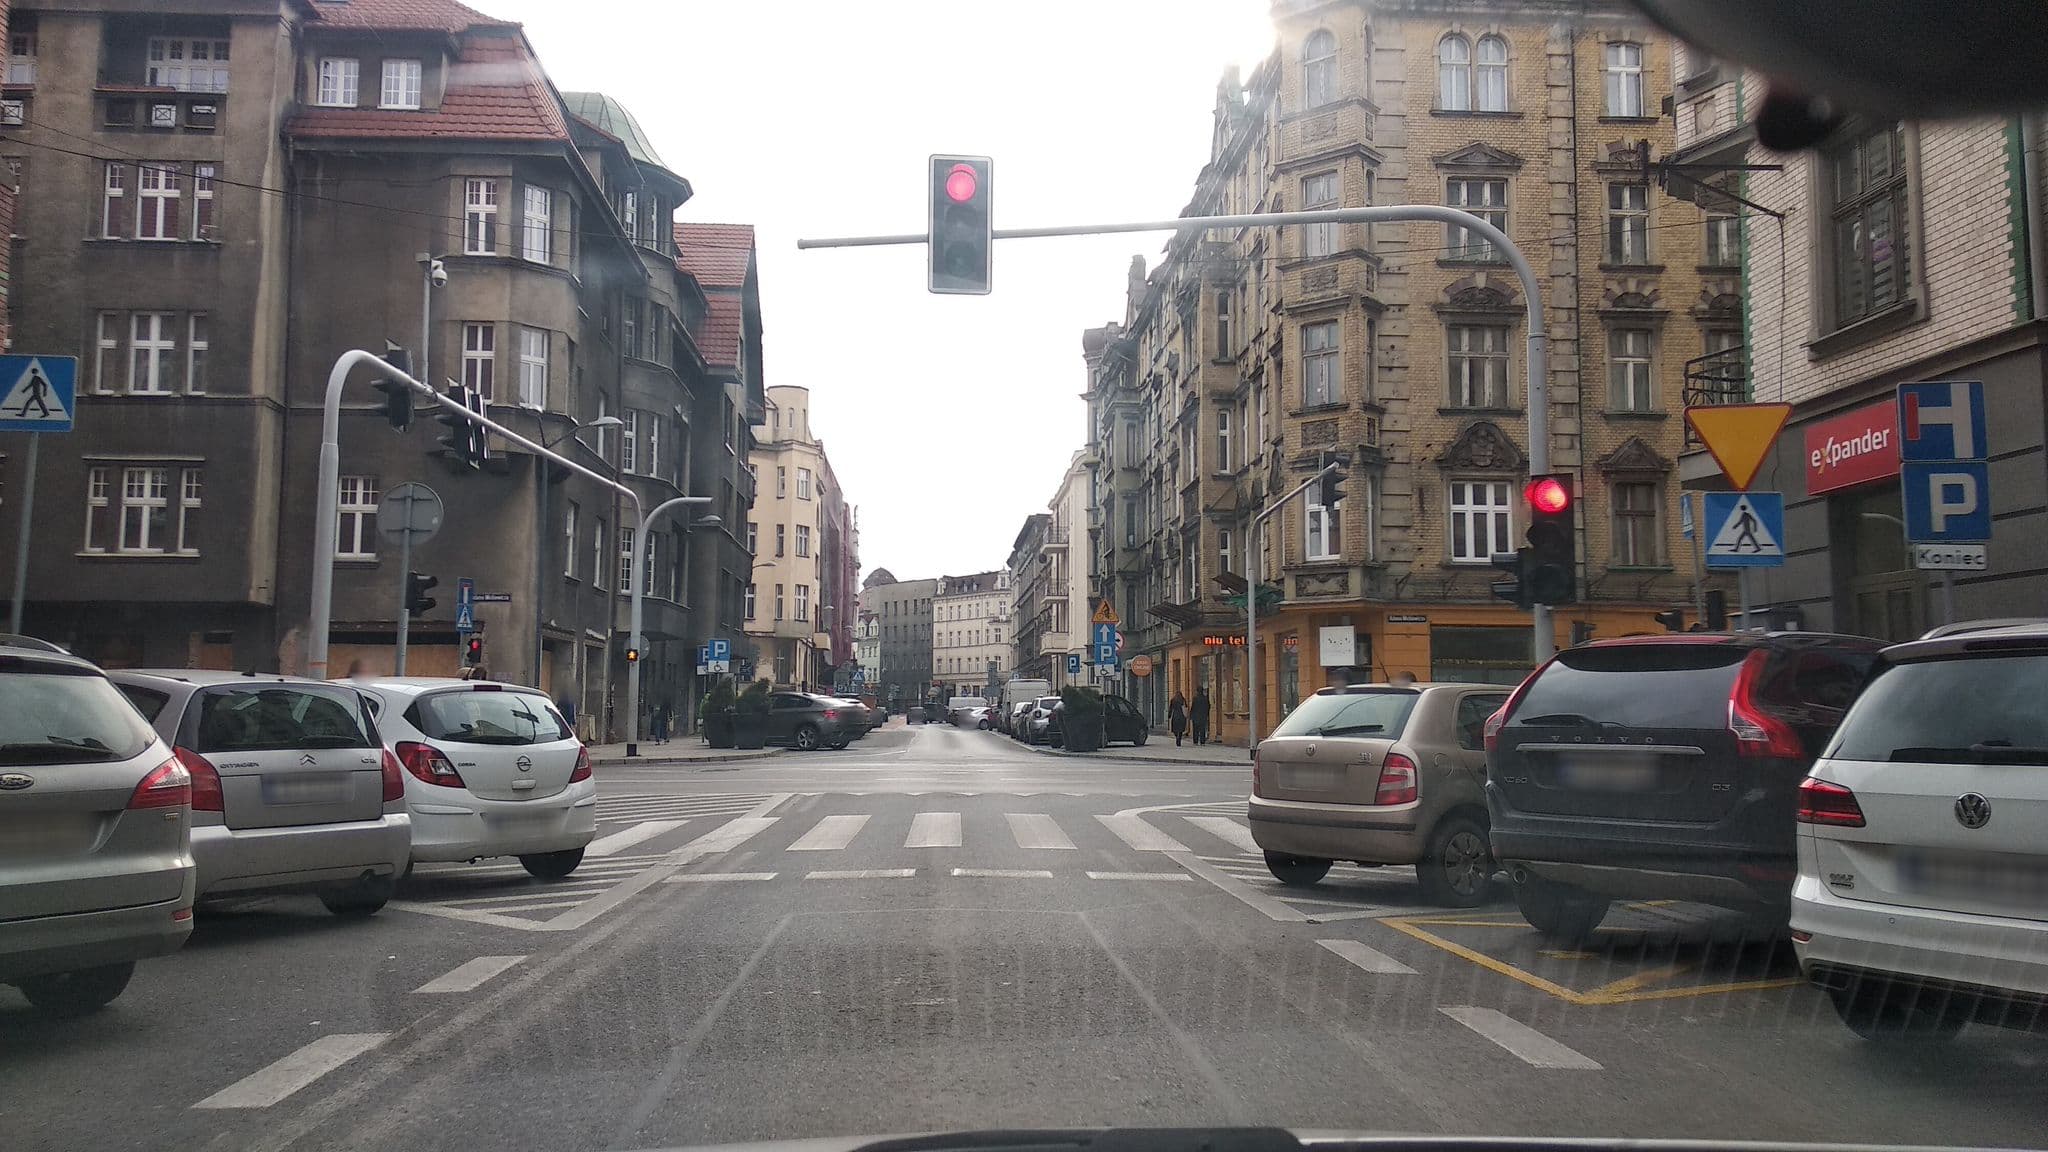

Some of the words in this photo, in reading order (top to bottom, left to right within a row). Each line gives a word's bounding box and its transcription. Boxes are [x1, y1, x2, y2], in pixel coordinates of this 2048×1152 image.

[1811, 428, 1890, 474] expander
[1929, 473, 1977, 533] P
[1919, 548, 1985, 565] Koniec
[714, 641, 727, 658] P
[1100, 645, 1113, 662] P
[1069, 657, 1077, 670] P
[1551, 735, 1653, 744] VOLVO
